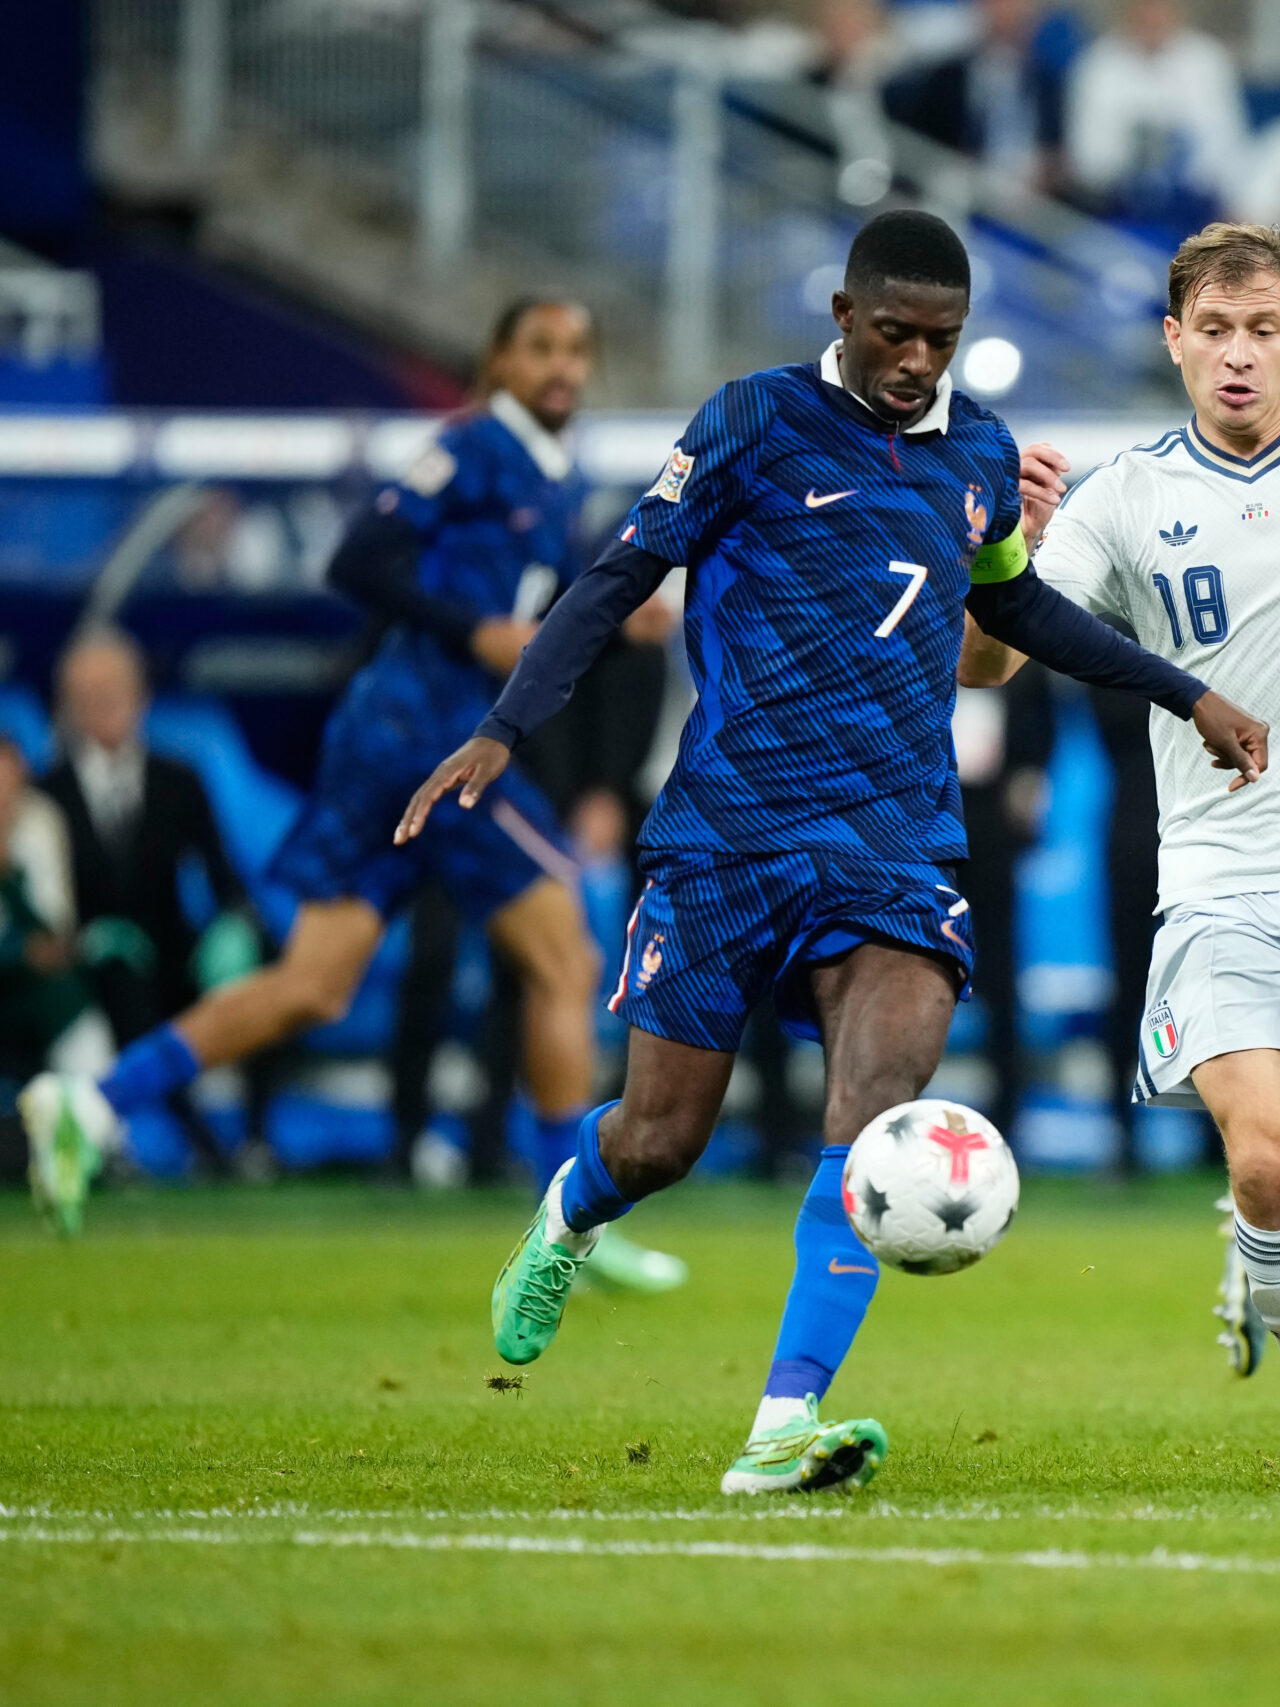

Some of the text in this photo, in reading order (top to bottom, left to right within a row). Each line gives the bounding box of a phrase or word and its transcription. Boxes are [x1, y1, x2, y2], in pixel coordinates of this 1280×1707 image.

[874, 560, 928, 638] 7
[1152, 565, 1229, 650] 18
[1149, 1011, 1170, 1028] ITALIA
